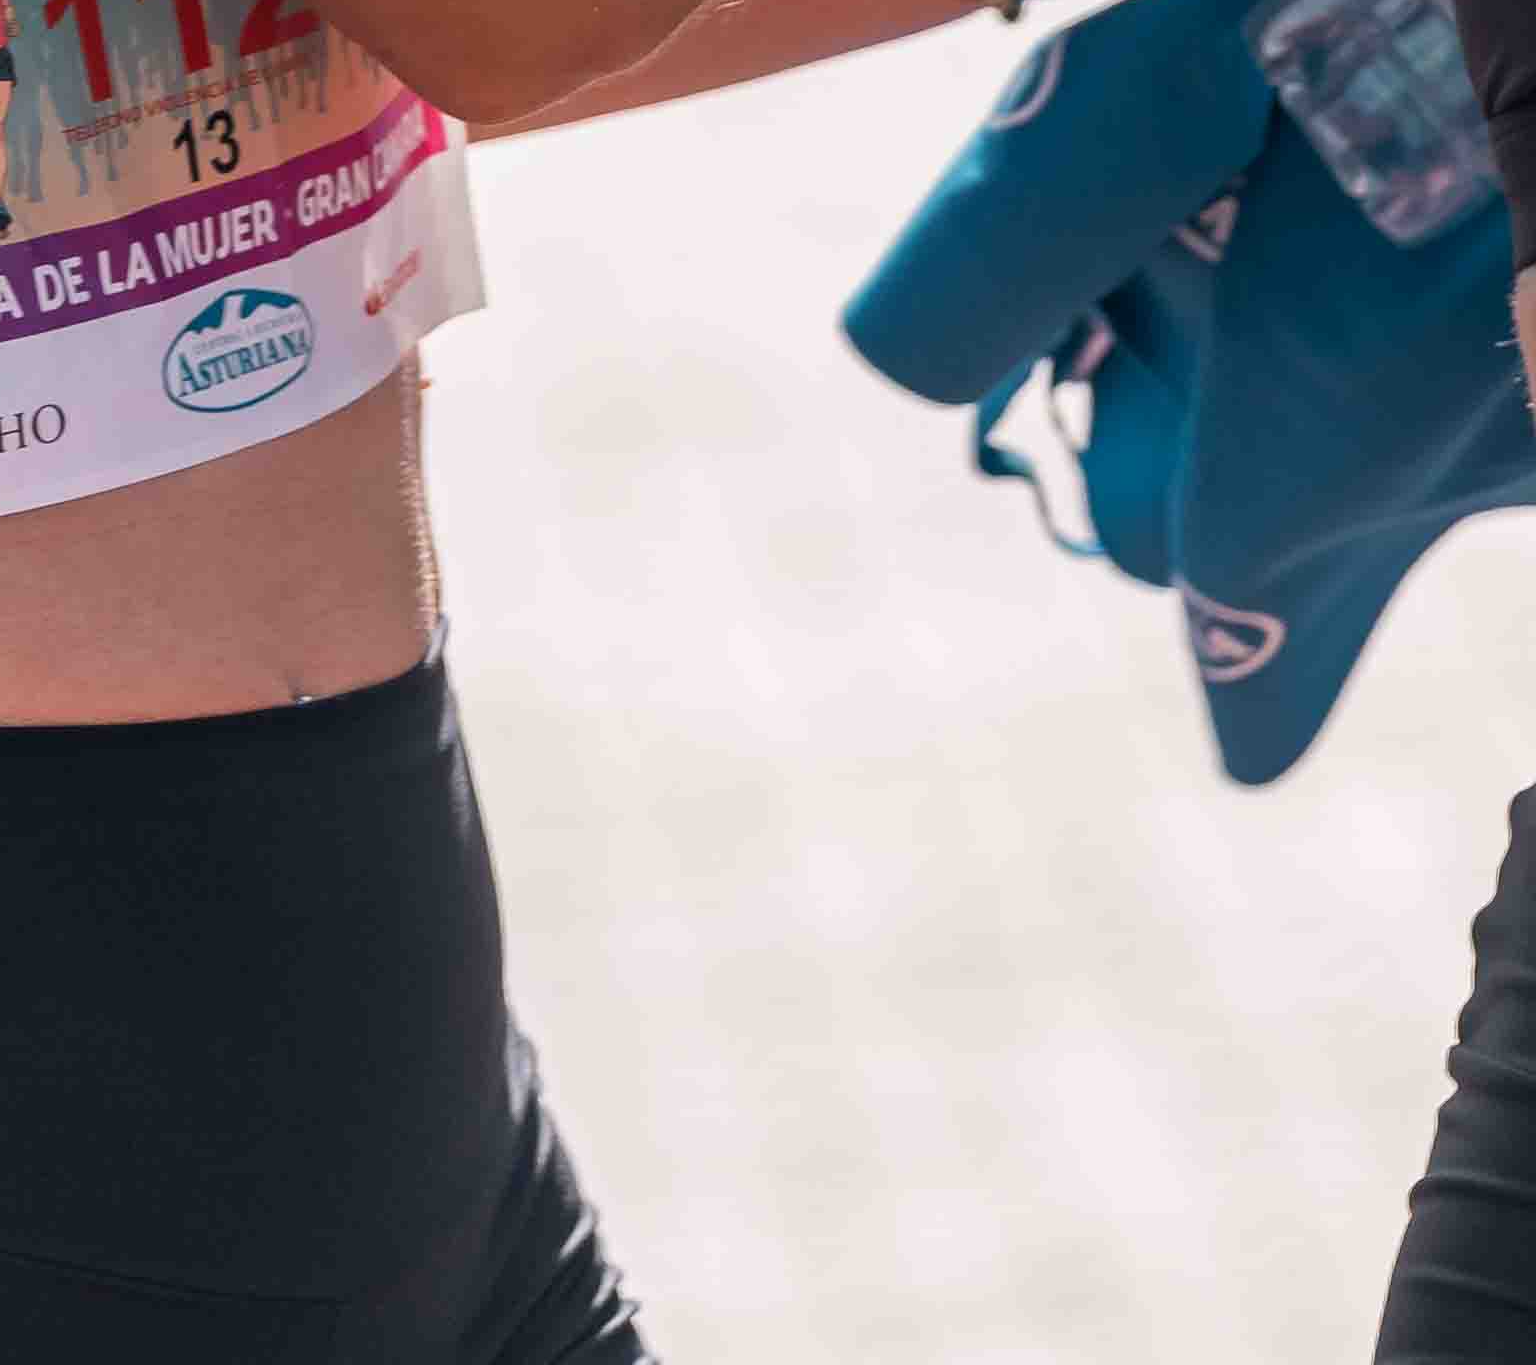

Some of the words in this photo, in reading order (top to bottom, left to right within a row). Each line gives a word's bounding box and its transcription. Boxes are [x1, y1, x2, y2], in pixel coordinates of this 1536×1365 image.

[172, 109, 241, 183] 13
[35, 257, 90, 313] DE
[99, 251, 157, 297] LA
[162, 200, 279, 280] MUJER
[297, 157, 371, 226] GRAN
[178, 327, 312, 397] ASTURIANA
